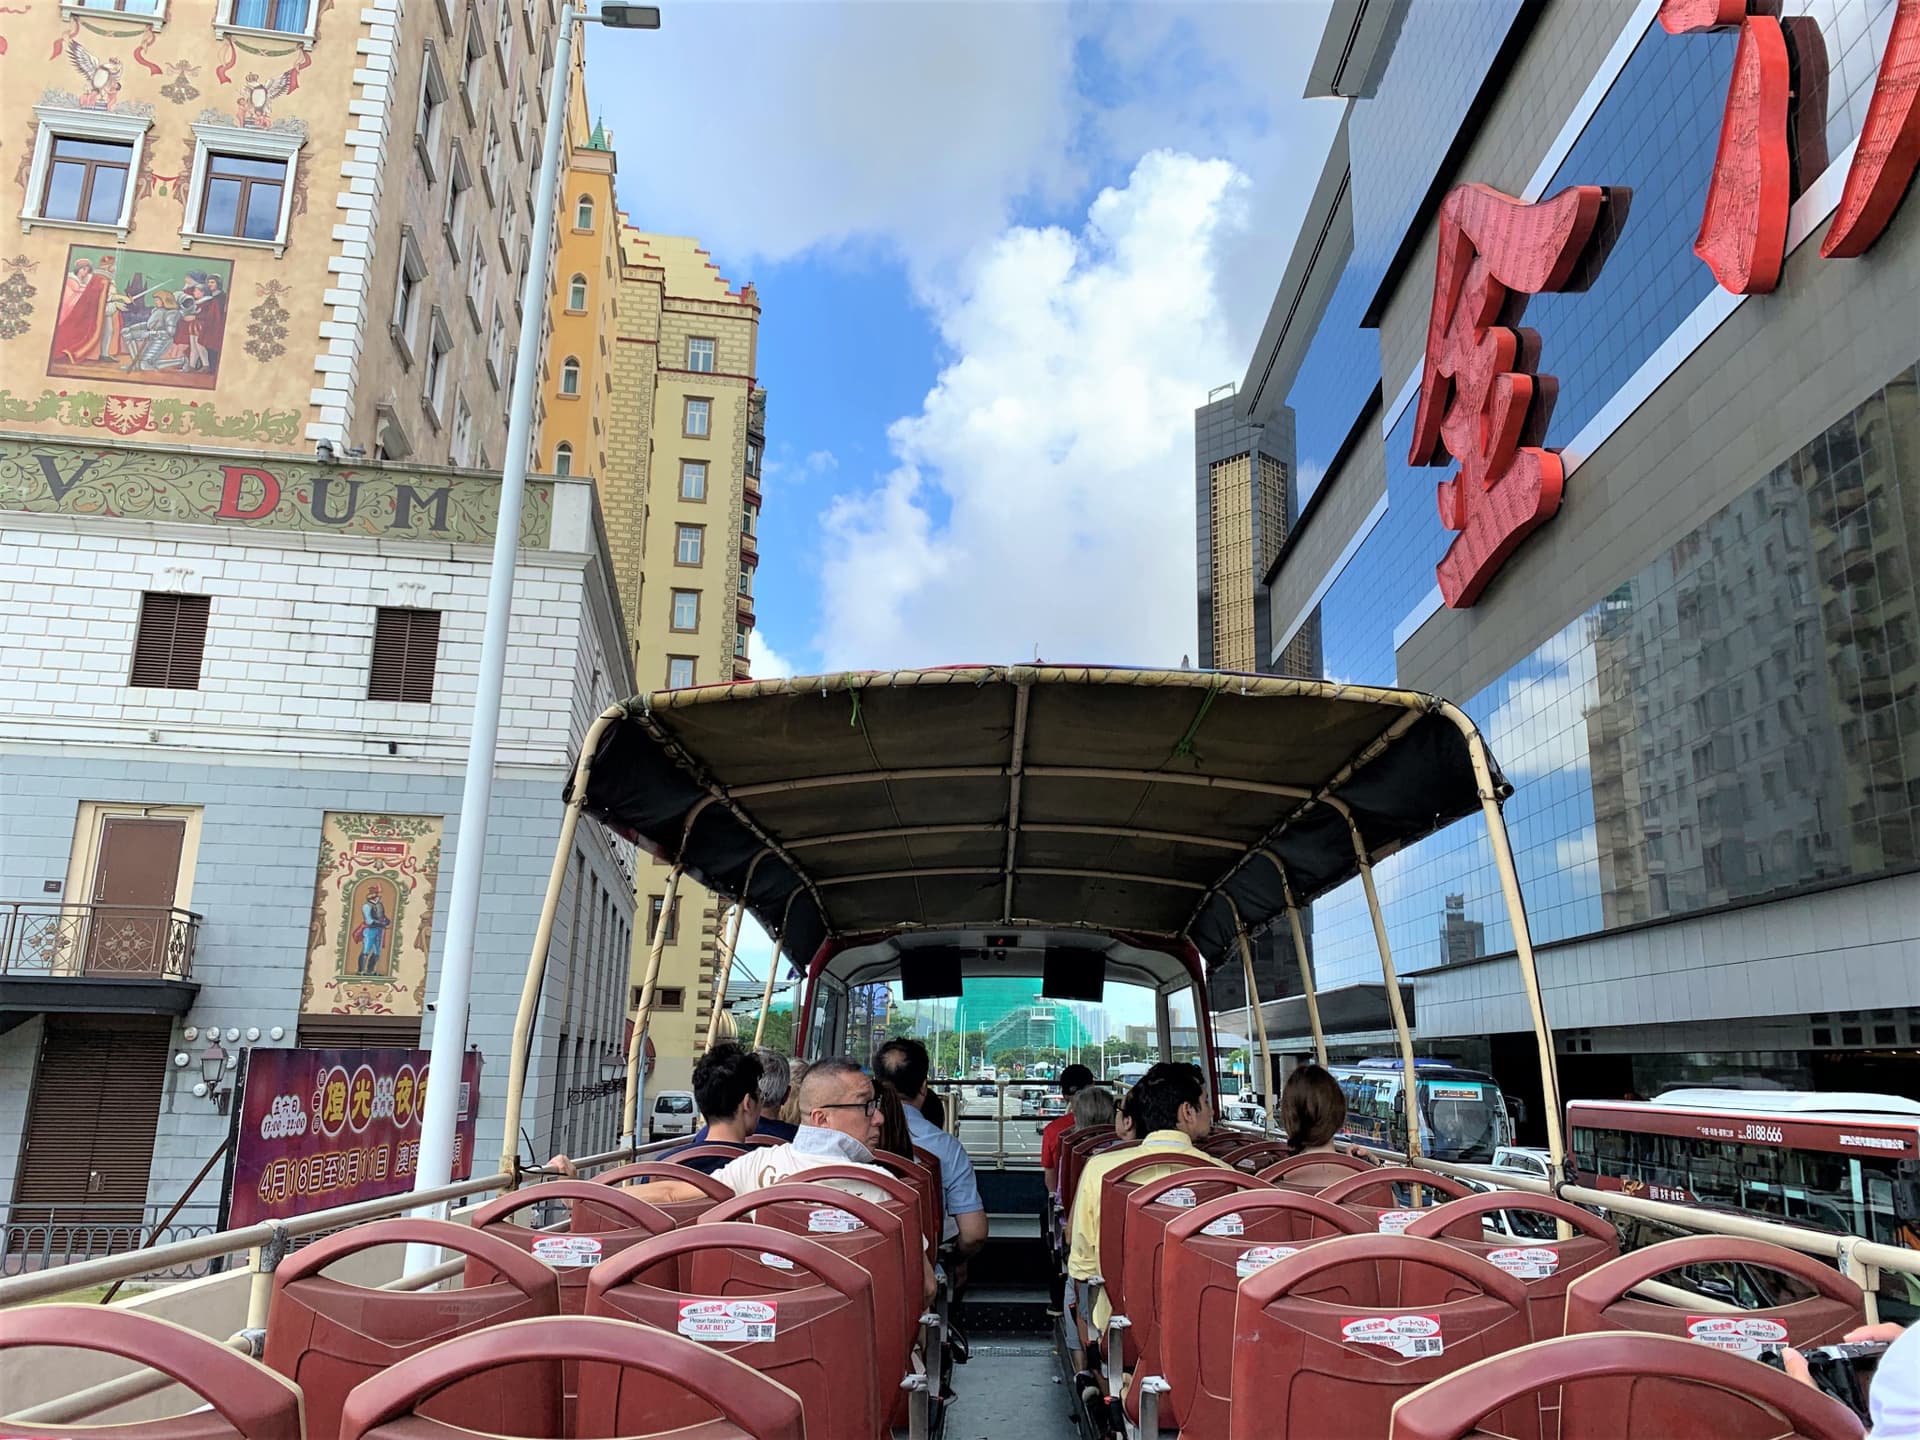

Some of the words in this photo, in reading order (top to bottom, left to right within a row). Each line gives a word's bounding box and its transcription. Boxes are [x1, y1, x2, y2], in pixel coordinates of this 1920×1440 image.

[0, 452, 100, 502] V
[213, 464, 451, 531] DUM
[273, 1099, 298, 1115] 五六日
[323, 1078, 371, 1122] 燈光
[259, 1147, 388, 1200] 4月18日至8月11日
